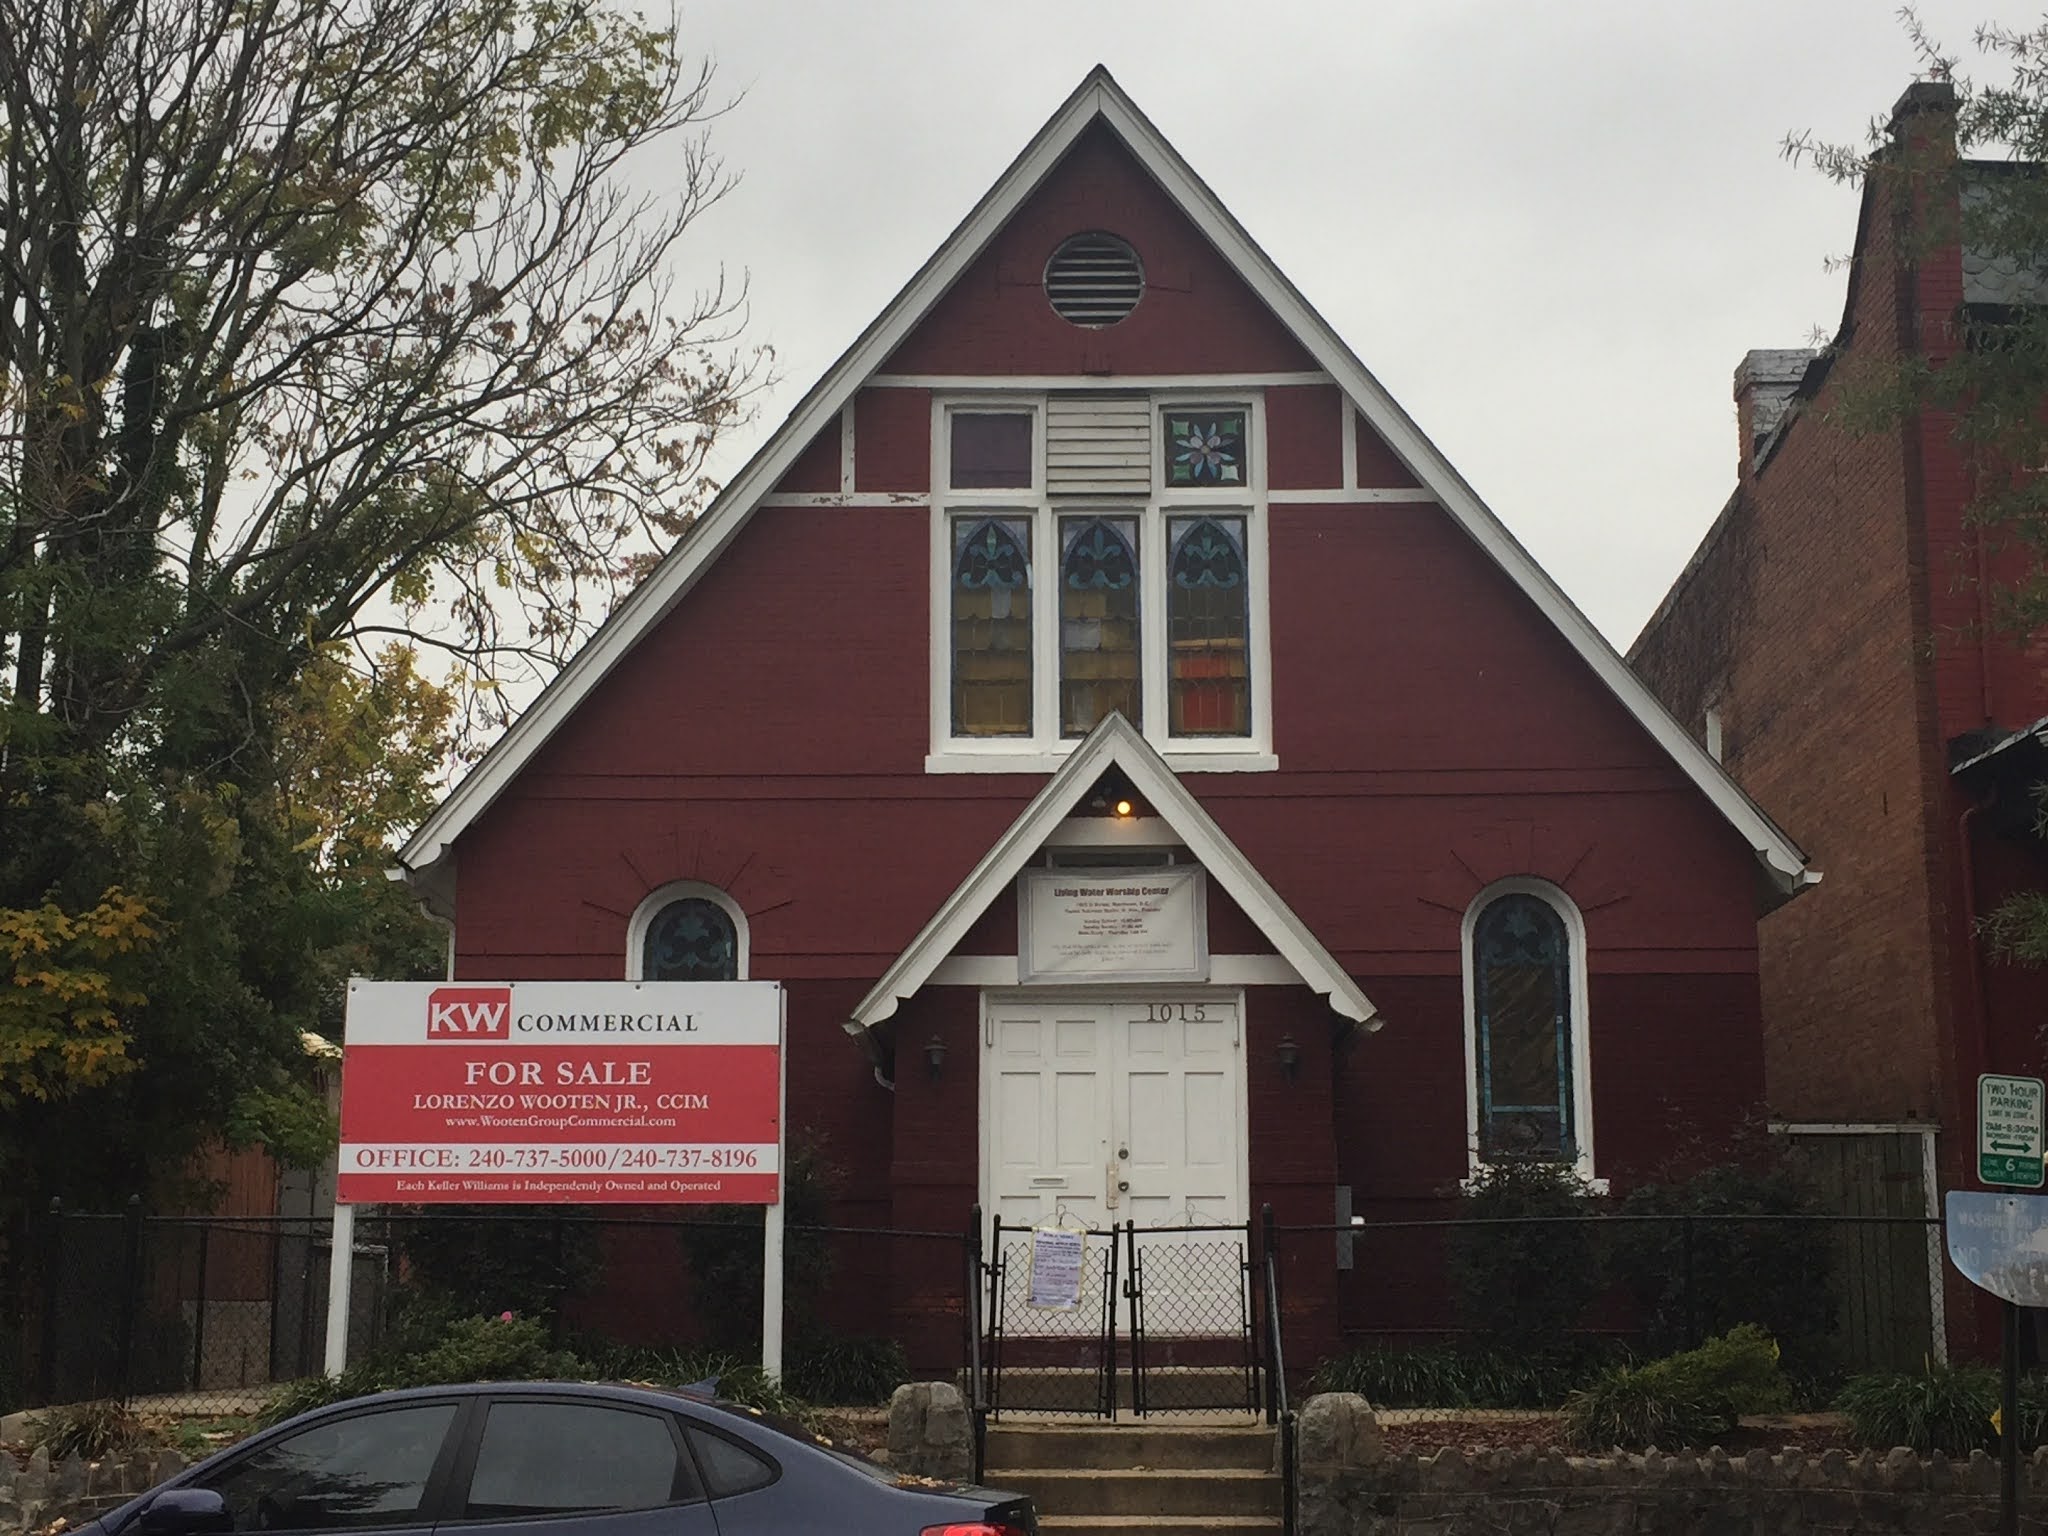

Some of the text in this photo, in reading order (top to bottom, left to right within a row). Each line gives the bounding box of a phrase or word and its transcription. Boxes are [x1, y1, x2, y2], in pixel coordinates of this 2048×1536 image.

[1054, 886, 1169, 898] Living Water Worship Center
[430, 1003, 699, 1033] KW COMMERCIAL
[1147, 1003, 1206, 1022] 1015
[464, 1061, 652, 1086] FOR SALE
[1986, 1083, 2039, 1098] TWO HOUR
[413, 1094, 709, 1113] LORENZO WOOTEN JR., CCIM
[1990, 1096, 2033, 1111] PARKING
[445, 1115, 677, 1128] www.WootenGroupCommercial.com
[356, 1147, 758, 1170] OFFICE: 240-737-5000/240-737-8196
[2005, 1157, 2016, 1171] 6
[396, 1180, 721, 1194] Each Keller Williams is Independently Owned and Operated
